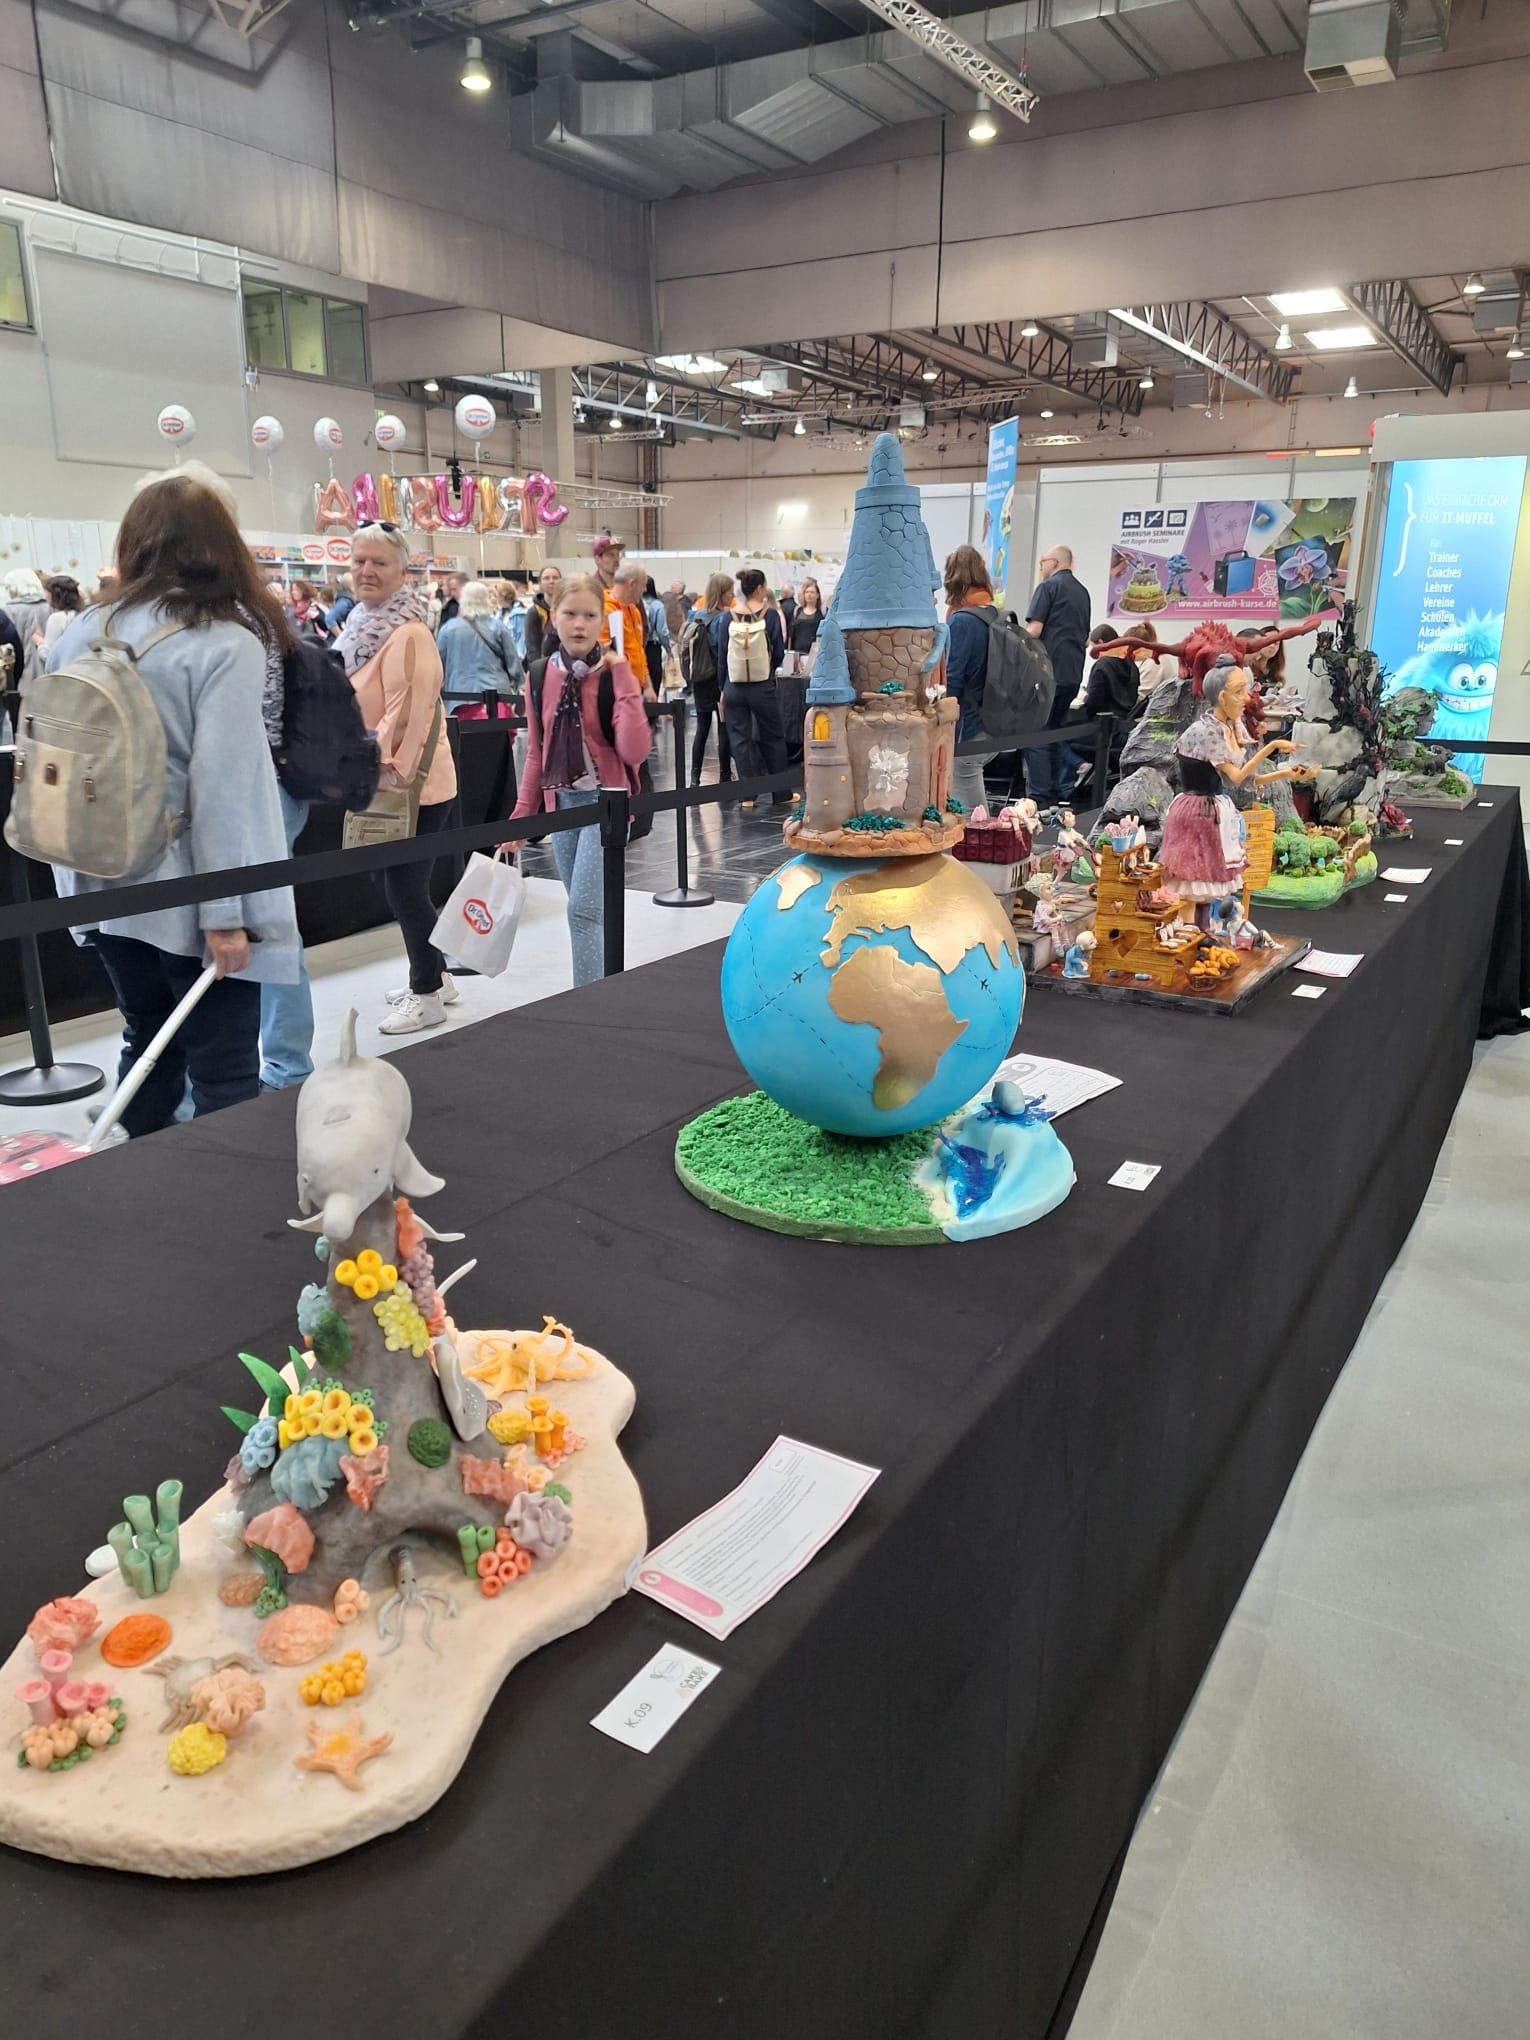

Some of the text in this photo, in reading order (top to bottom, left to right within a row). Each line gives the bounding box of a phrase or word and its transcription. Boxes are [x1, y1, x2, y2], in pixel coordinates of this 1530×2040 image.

[1420, 511, 1495, 525] FÜR IT-MUFFEL
[1121, 529, 1185, 538] AIRBRUSH SEMINARE
[1132, 538, 1148, 547] Roger
[1429, 552, 1460, 563] Trainer
[1426, 567, 1462, 578] Coaches
[1425, 582, 1453, 593] Lehrer
[1178, 598, 1278, 609] www.airbrush-kurse.de
[1423, 597, 1455, 608] Vereine
[1420, 611, 1456, 623] Schulen
[1417, 641, 1469, 653] Handwerker
[623, 1702, 652, 1728] K.09
